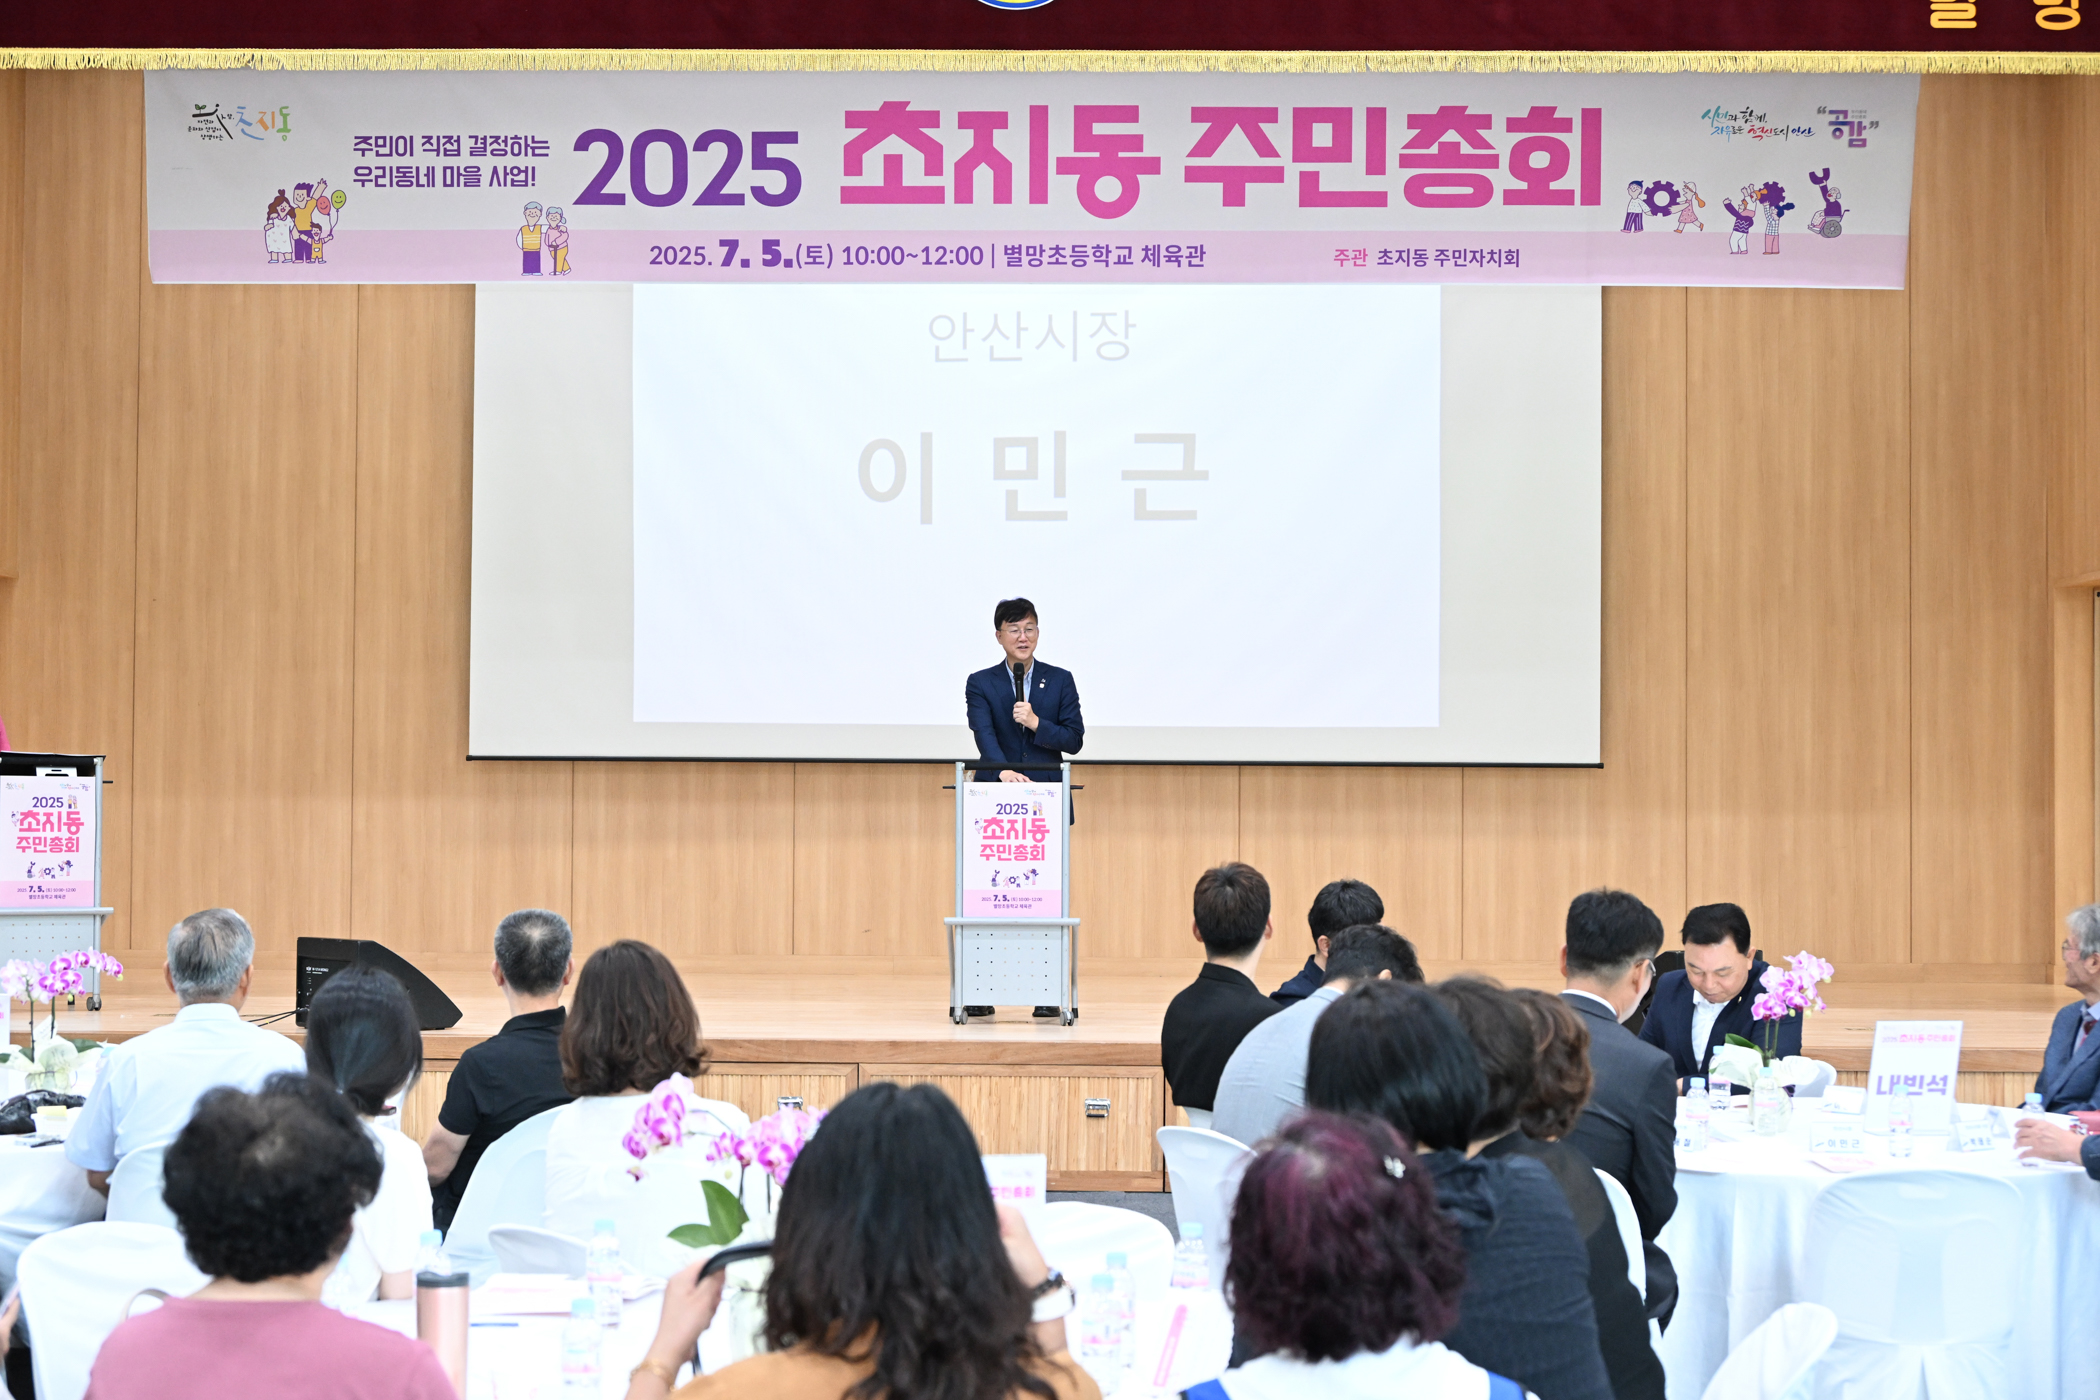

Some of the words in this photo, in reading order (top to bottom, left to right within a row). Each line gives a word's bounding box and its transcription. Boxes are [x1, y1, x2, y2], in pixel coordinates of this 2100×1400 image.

[235, 106, 291, 142] 초지동
[1701, 105, 1740, 127] 시민과
[1710, 125, 1744, 142] 자유로운
[1747, 125, 1789, 141] 혁신도시
[1791, 126, 1815, 138] 안산
[353, 135, 415, 158] 주민이
[420, 135, 462, 158] 직접
[468, 134, 550, 158] 결정하는
[572, 128, 802, 208] 2025
[840, 101, 1161, 220] 초지동
[1184, 104, 1603, 209] 주민총회
[353, 165, 436, 189] 우리동네
[442, 165, 482, 188] 마을
[489, 165, 536, 188] 사업!
[649, 245, 712, 267] 2025.
[719, 239, 750, 268] 7.
[842, 246, 984, 266] 10:00~12:00
[1003, 244, 1135, 268] 별망초등학교
[1141, 244, 1207, 268] 체육관
[1334, 247, 1369, 267] 주관
[1377, 247, 1430, 268] 초지동
[1434, 248, 1520, 268] 주민자치회
[928, 309, 1137, 363] 안산시장
[32, 796, 64, 809] 2025
[995, 803, 1029, 815] 2025
[19, 810, 84, 836] 초지동
[982, 817, 1050, 843] 초지동
[16, 836, 80, 854] 주민총회
[980, 844, 1046, 861] 주민총회
[993, 894, 1001, 902] 7.
[1876, 1074, 1948, 1096] 내빈석
